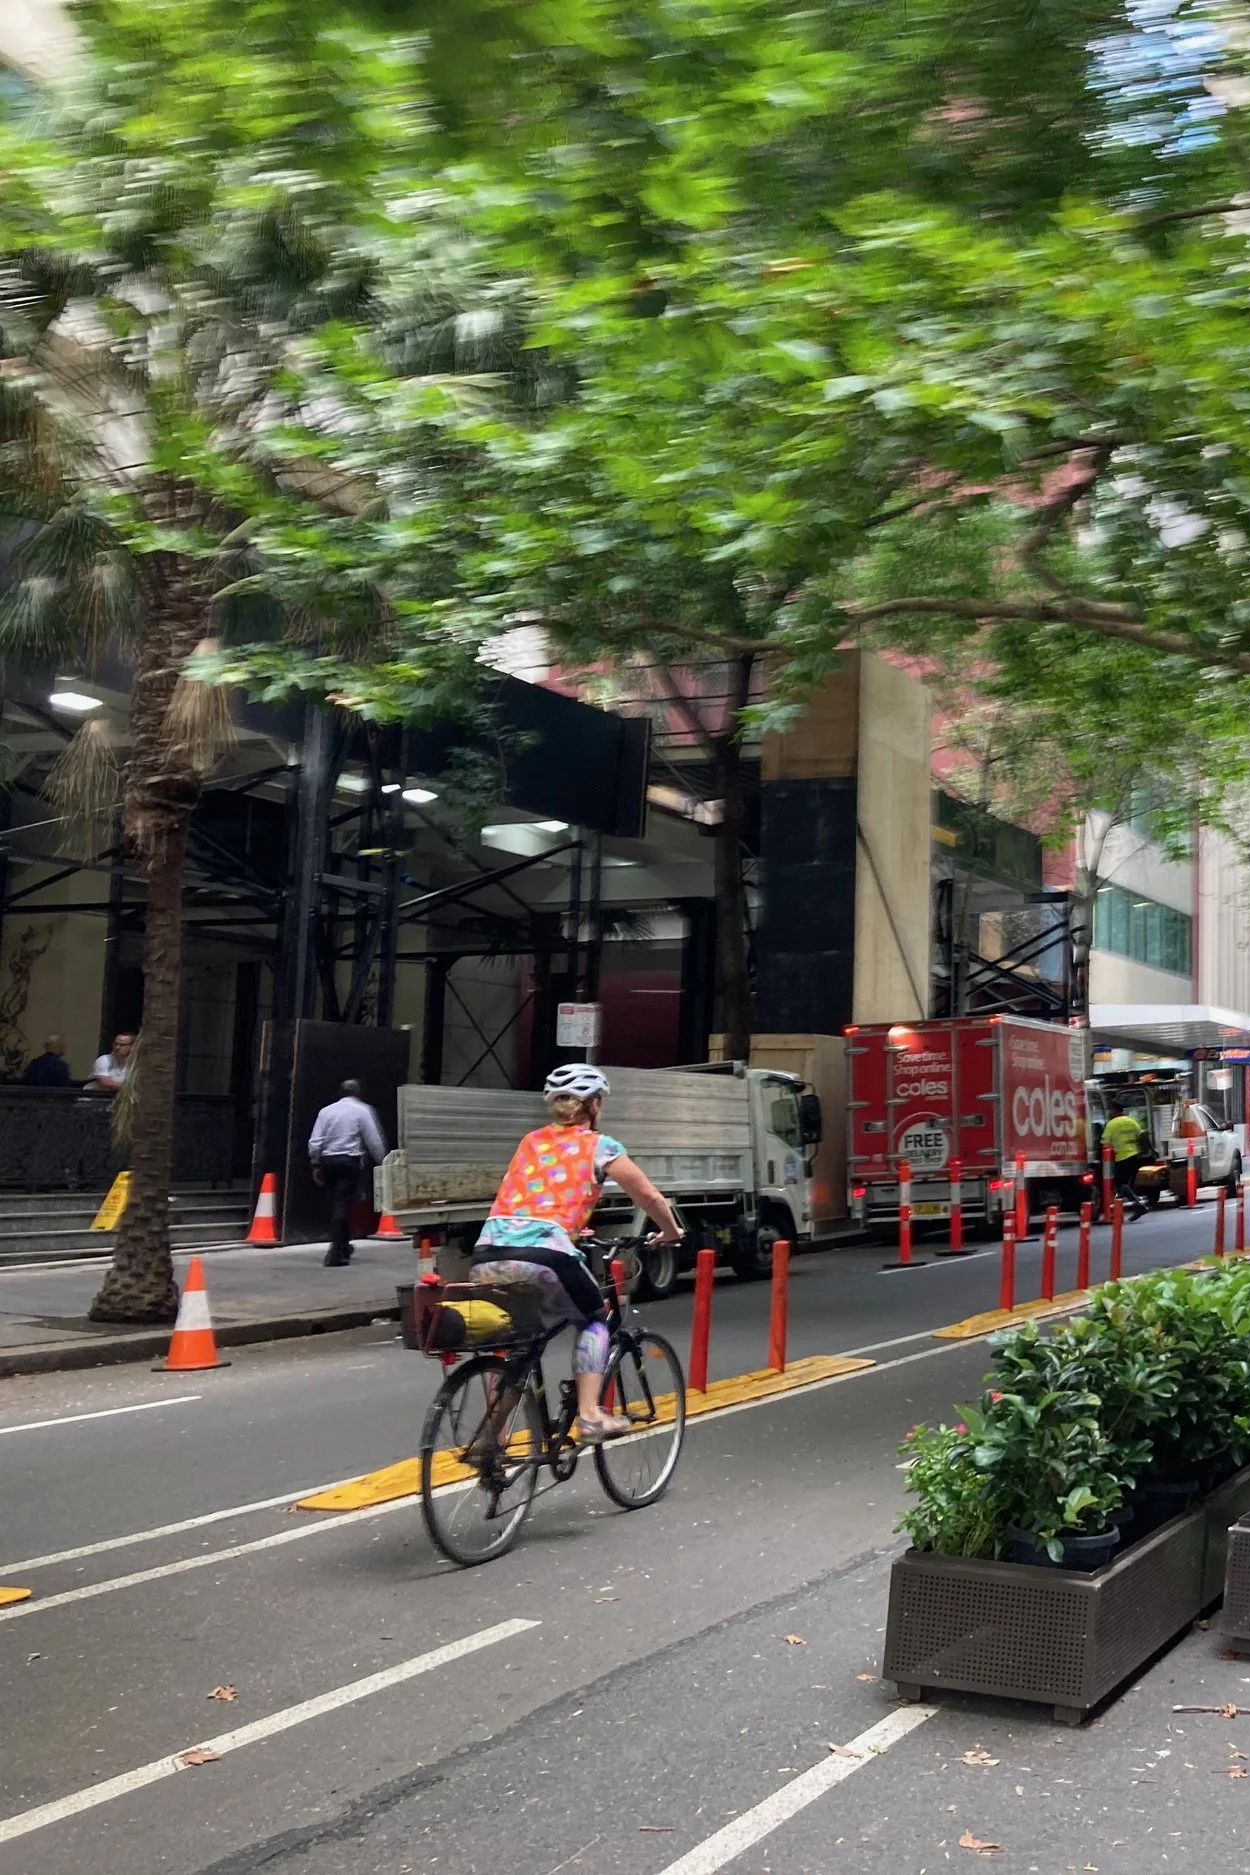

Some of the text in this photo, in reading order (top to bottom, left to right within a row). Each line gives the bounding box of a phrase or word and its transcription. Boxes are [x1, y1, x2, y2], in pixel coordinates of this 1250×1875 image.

[896, 1078, 948, 1097] coles
[1012, 1073, 1077, 1137] coles
[903, 1132, 943, 1149] FREE
